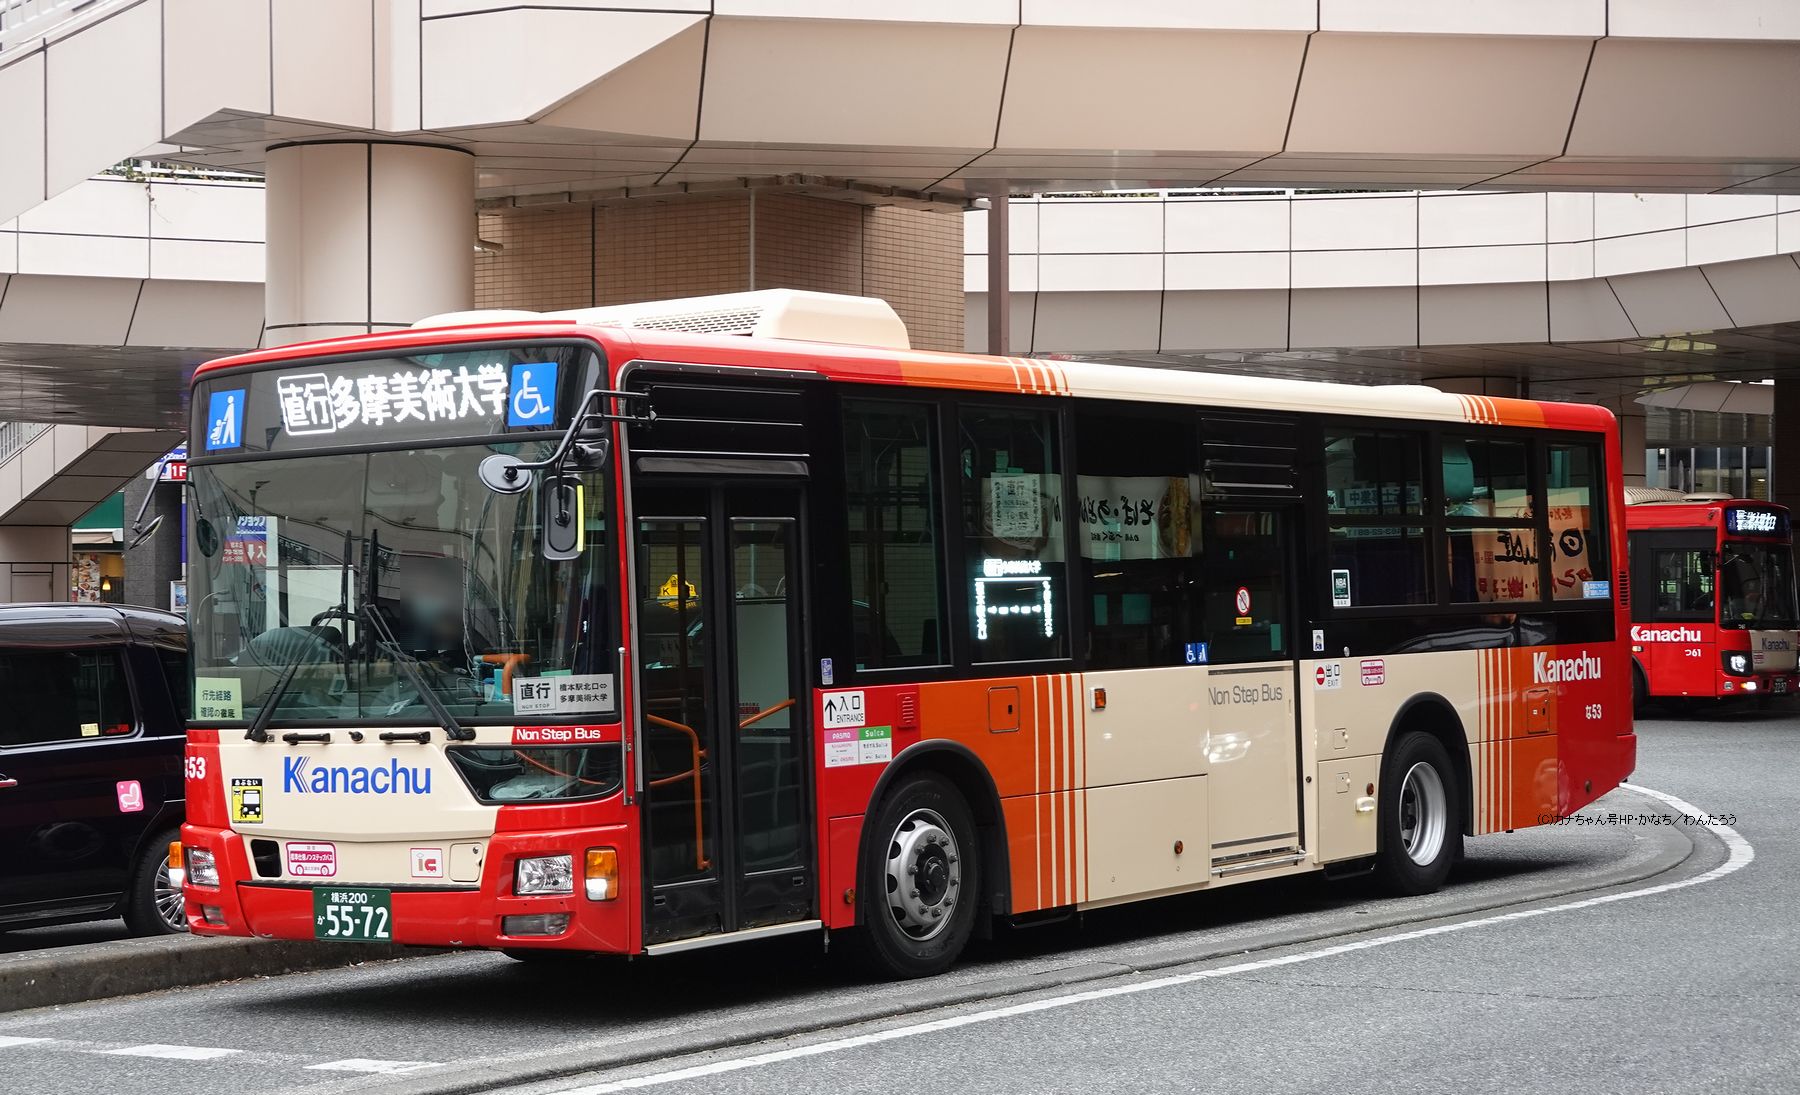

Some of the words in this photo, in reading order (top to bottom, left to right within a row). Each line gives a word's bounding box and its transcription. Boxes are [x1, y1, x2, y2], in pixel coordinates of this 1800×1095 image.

[280, 381, 331, 428] 直行
[330, 363, 508, 429] 多摩美術大学
[1631, 625, 1701, 642] Kanachu
[1762, 637, 1790, 650] Kanachu
[1684, 649, 1701, 657] つ61
[1533, 650, 1601, 684] Kanachu
[1327, 679, 1339, 687] EXIT
[202, 690, 232, 701] 行先経路
[520, 682, 551, 700] 直行
[1208, 687, 1230, 705] Non
[1233, 685, 1259, 705] Step
[1262, 683, 1283, 701] Bus
[560, 693, 608, 703] 多摩美術大学
[839, 695, 860, 710] 入口
[200, 707, 235, 719] 確認の徹底
[836, 713, 864, 723] ENTRANCE
[516, 729, 539, 740] Non
[541, 728, 572, 741] Step
[574, 727, 601, 739] Bus
[865, 729, 884, 737] Suica
[284, 756, 431, 794] Kanachu
[331, 892, 368, 904] 横浜200
[317, 914, 325, 925] か
[326, 905, 389, 938] 55-72
